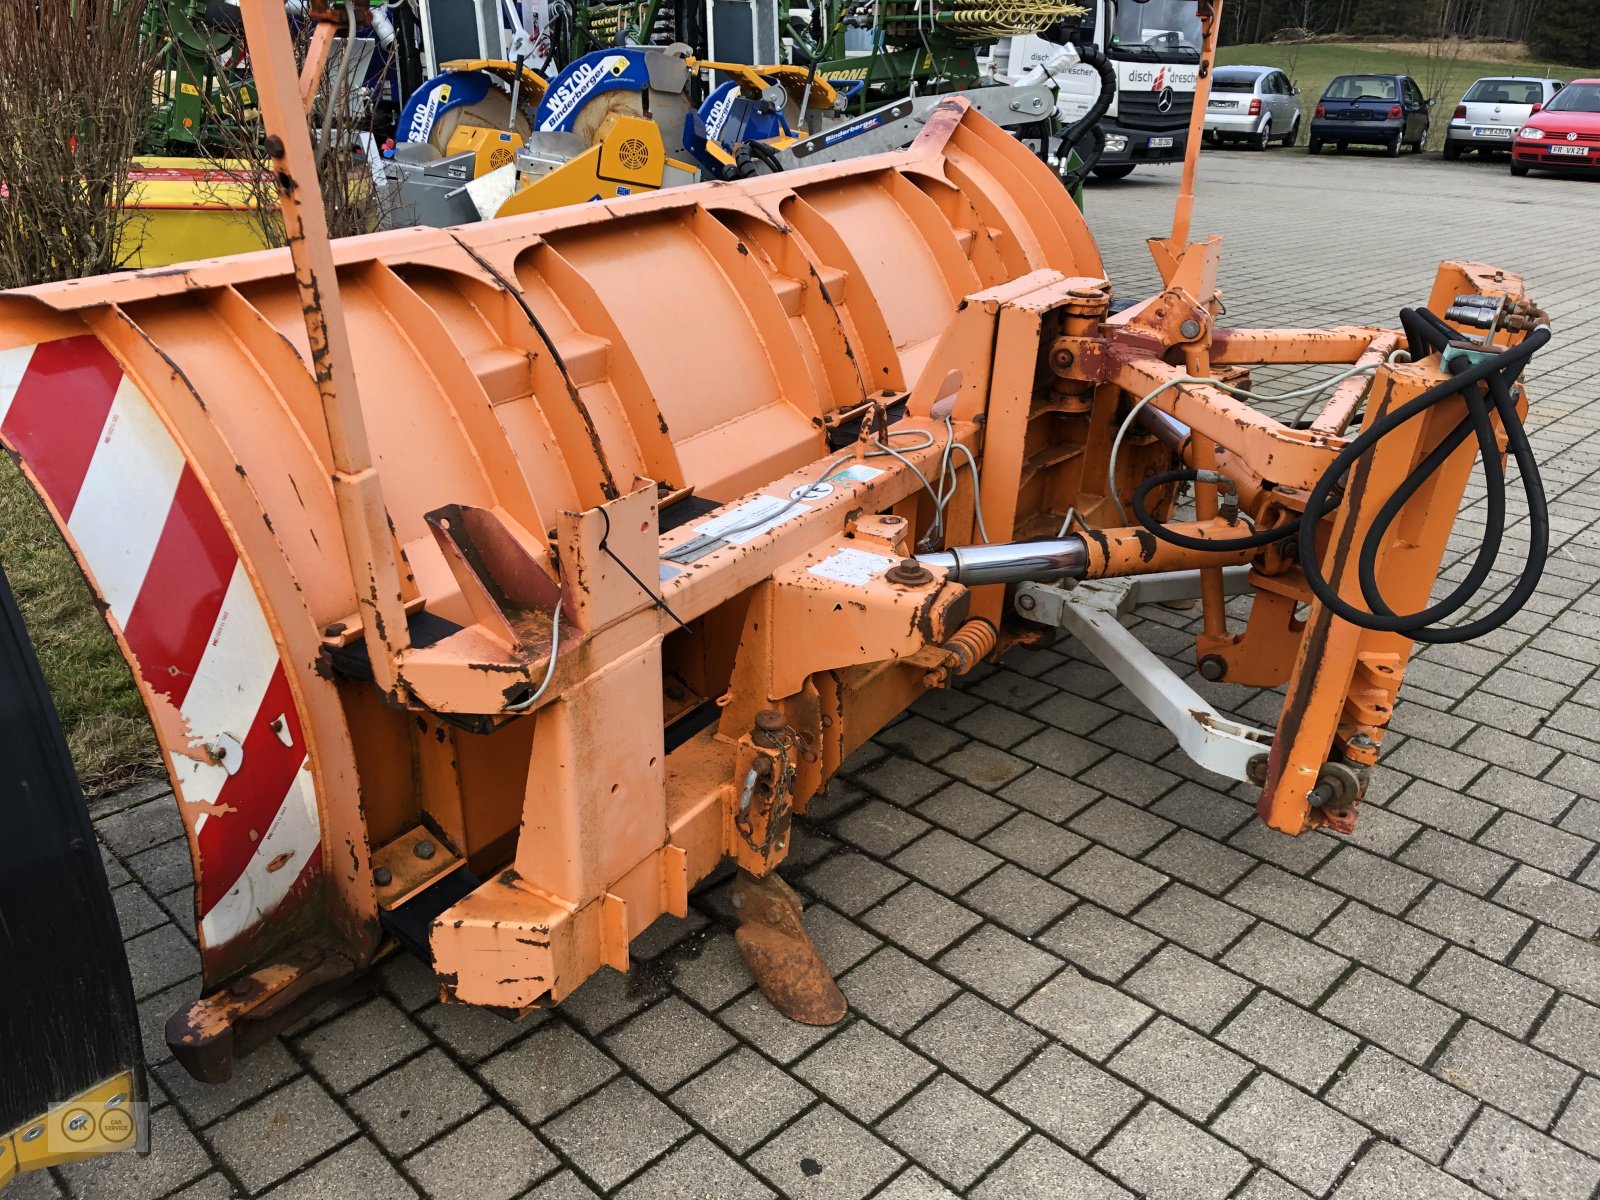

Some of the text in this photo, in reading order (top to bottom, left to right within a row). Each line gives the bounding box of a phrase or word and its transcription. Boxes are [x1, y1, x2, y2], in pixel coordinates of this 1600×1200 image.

[546, 63, 593, 112] WS700
[822, 68, 869, 81] KRONE
[1128, 70, 1153, 83] disch
[548, 65, 605, 128] Binderberger
[407, 103, 428, 143] S700
[705, 100, 723, 140] S700
[825, 118, 877, 143] Binderberger
